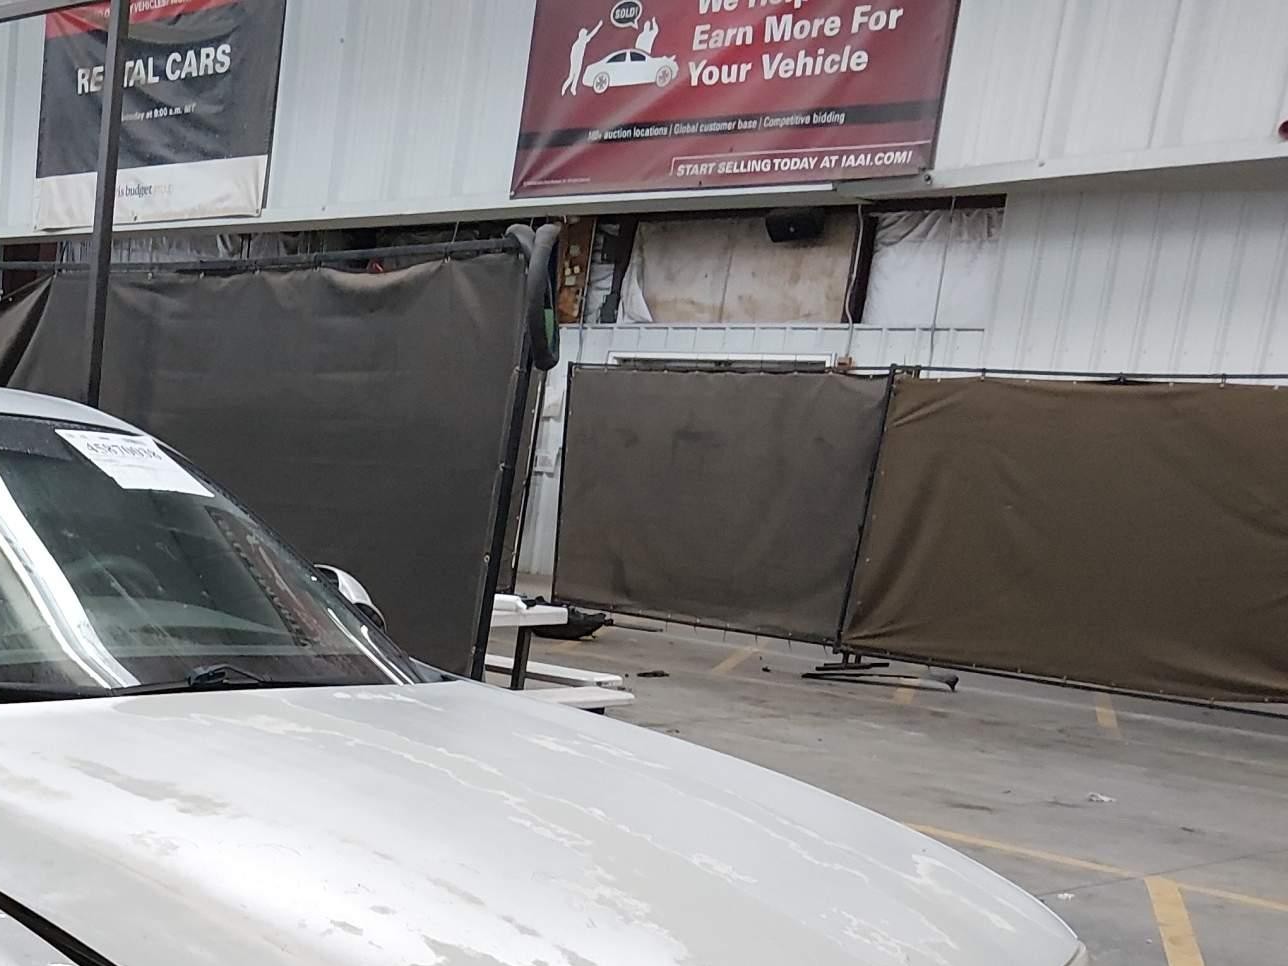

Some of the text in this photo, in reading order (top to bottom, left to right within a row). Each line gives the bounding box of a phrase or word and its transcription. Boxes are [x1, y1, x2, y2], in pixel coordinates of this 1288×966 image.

[615, 6, 638, 19] SOLD!
[692, 4, 904, 51] Earn More For
[77, 43, 231, 94] RETAL CARS
[688, 45, 869, 87] Your Vehicle
[603, 128, 632, 140] auction
[633, 126, 668, 139] locations
[673, 122, 698, 135] Global
[699, 120, 736, 133] customer
[737, 118, 757, 130] base
[763, 114, 811, 130] Competitive
[813, 111, 845, 125] bidding
[676, 150, 913, 177] START SELLING TODAY AT IAAI.COM!
[125, 183, 152, 198] budget
